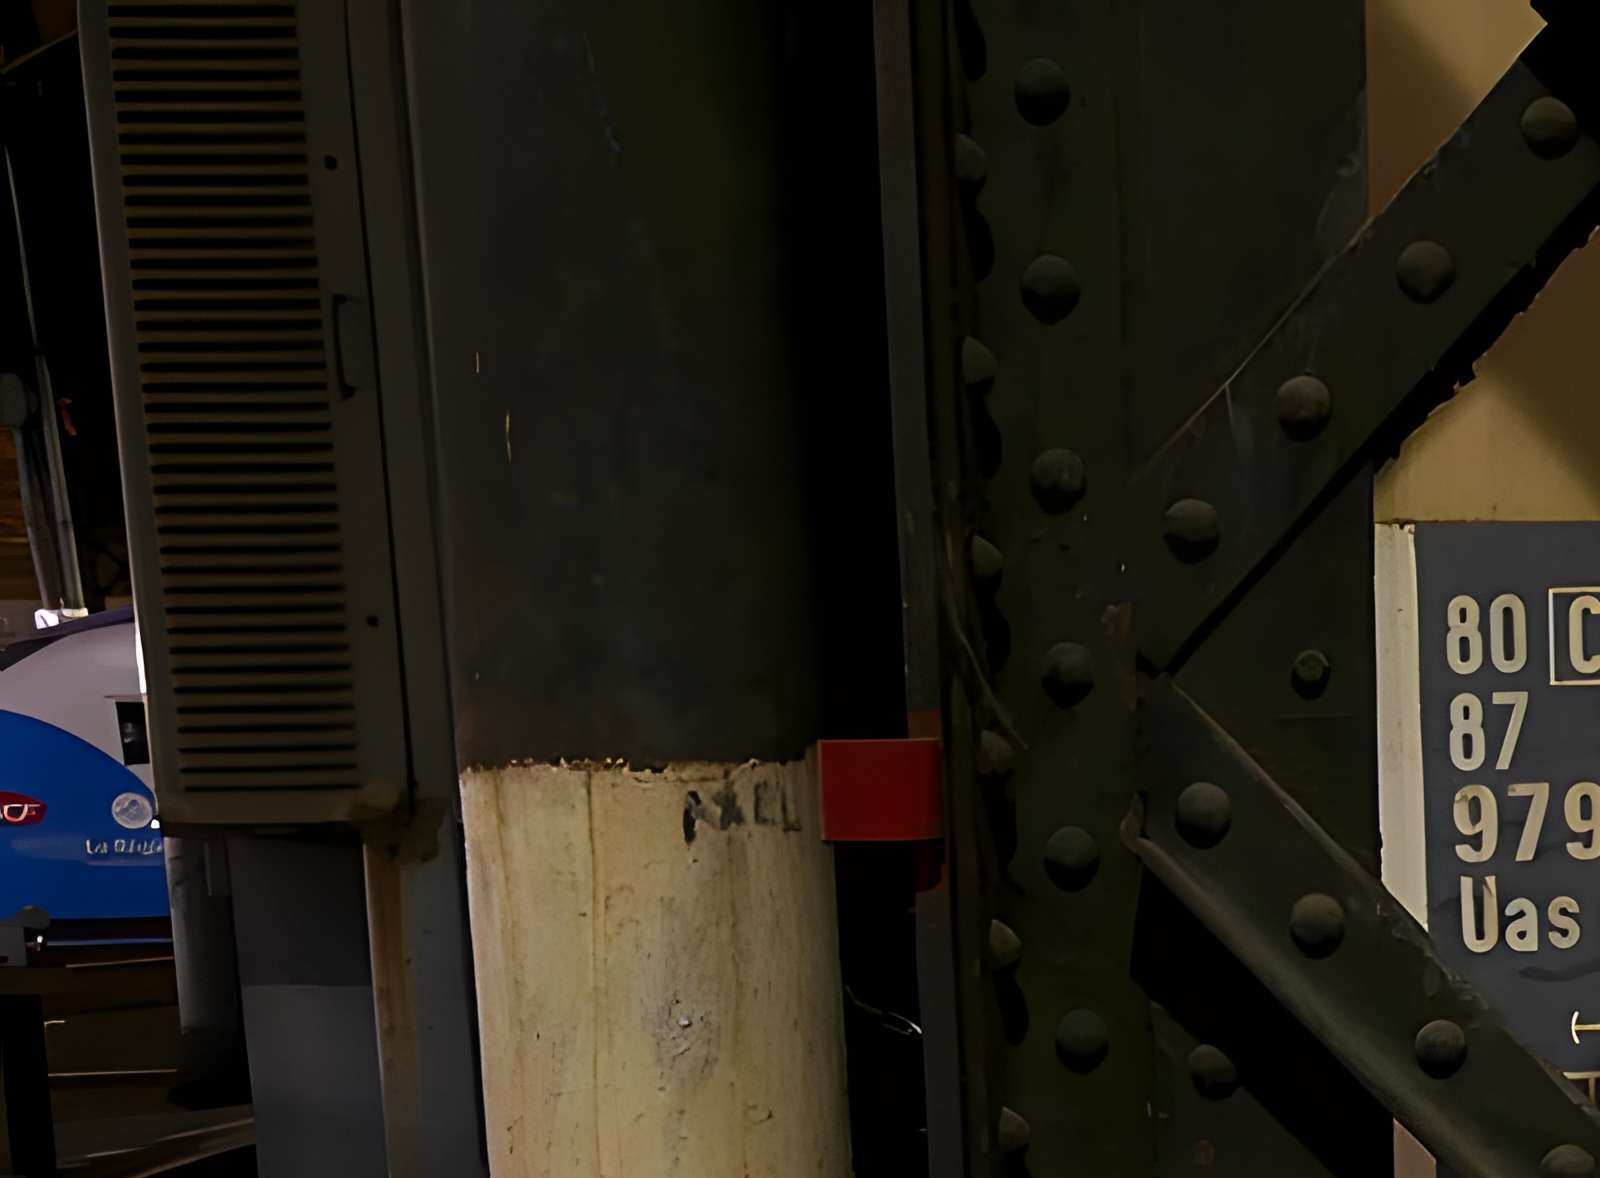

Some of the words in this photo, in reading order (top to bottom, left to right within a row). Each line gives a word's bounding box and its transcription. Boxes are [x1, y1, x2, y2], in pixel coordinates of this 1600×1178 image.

[1446, 593, 1528, 675] 80
[1449, 690, 1529, 771] 87
[1460, 874, 1582, 954] Uas
